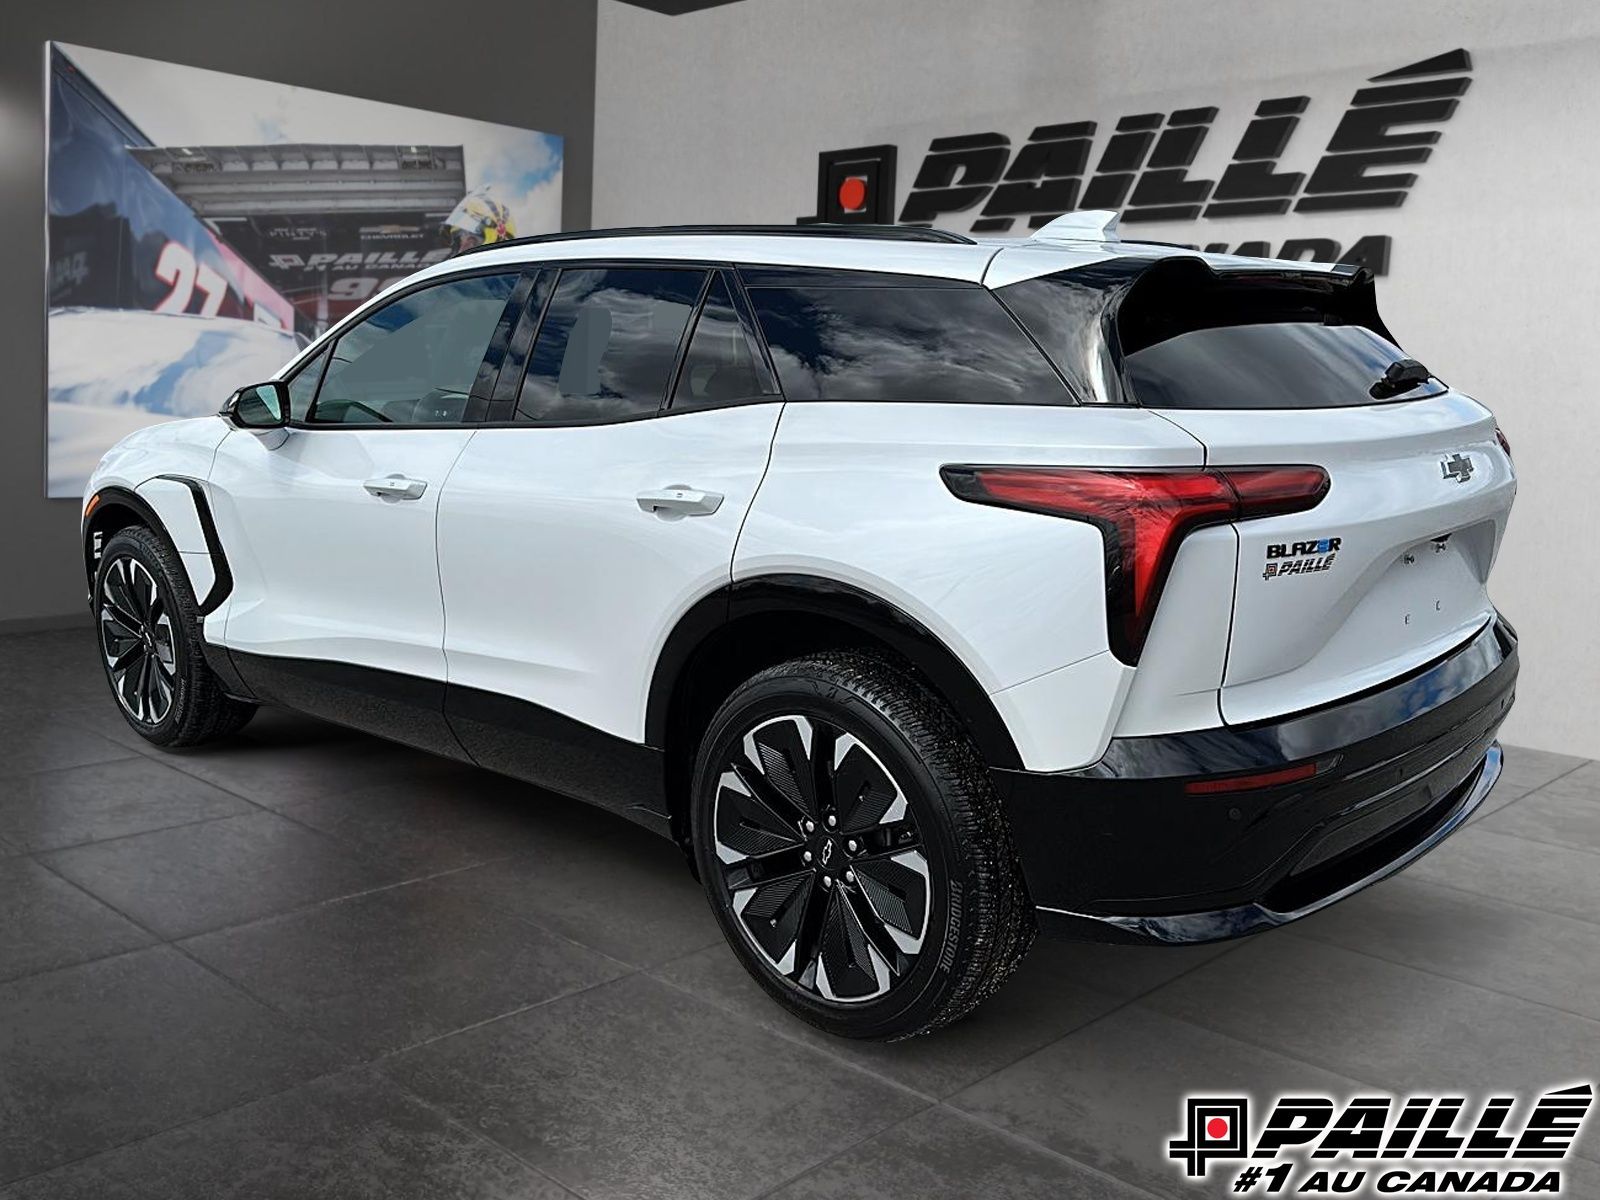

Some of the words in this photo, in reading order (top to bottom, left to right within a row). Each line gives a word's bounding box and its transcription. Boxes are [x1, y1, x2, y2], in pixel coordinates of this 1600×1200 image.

[899, 48, 1472, 232] PAILLÉ
[364, 262, 432, 270] CANAD
[1266, 537, 1342, 559] BLAZER
[939, 879, 964, 974] BRIDGESTONE
